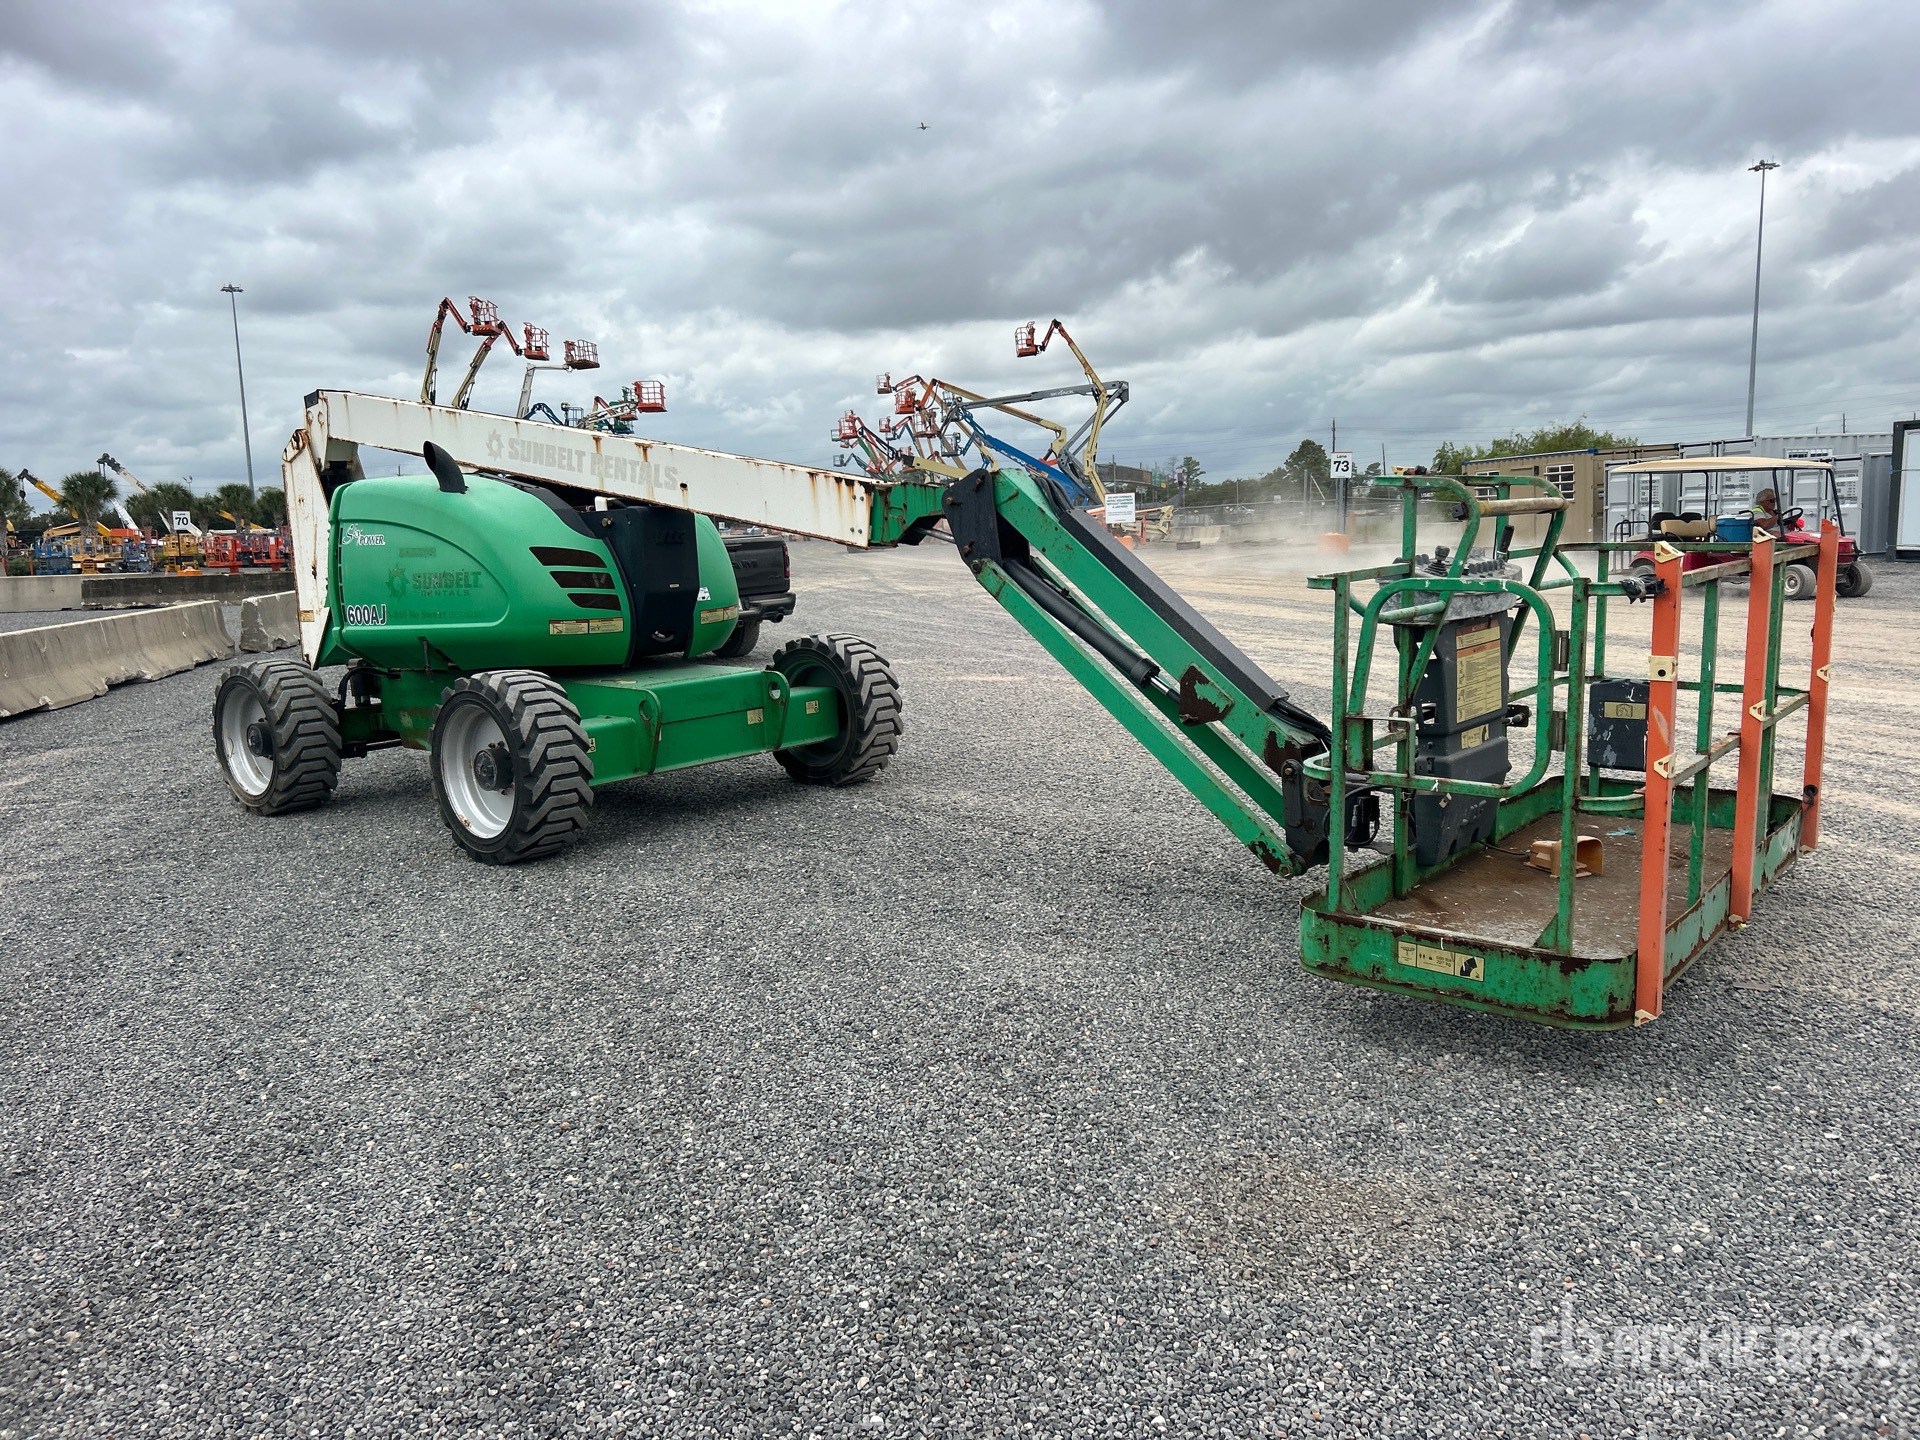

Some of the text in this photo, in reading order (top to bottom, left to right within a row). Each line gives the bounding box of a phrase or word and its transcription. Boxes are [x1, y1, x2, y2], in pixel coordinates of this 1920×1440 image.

[508, 437, 679, 491] SUNBELT RENTALS
[1333, 460, 1350, 472] 73
[175, 516, 188, 525] 70
[359, 534, 386, 546] POWER
[412, 571, 482, 590] SUNBELT
[421, 589, 471, 597] RENTALS
[347, 603, 387, 626] 600AJ
